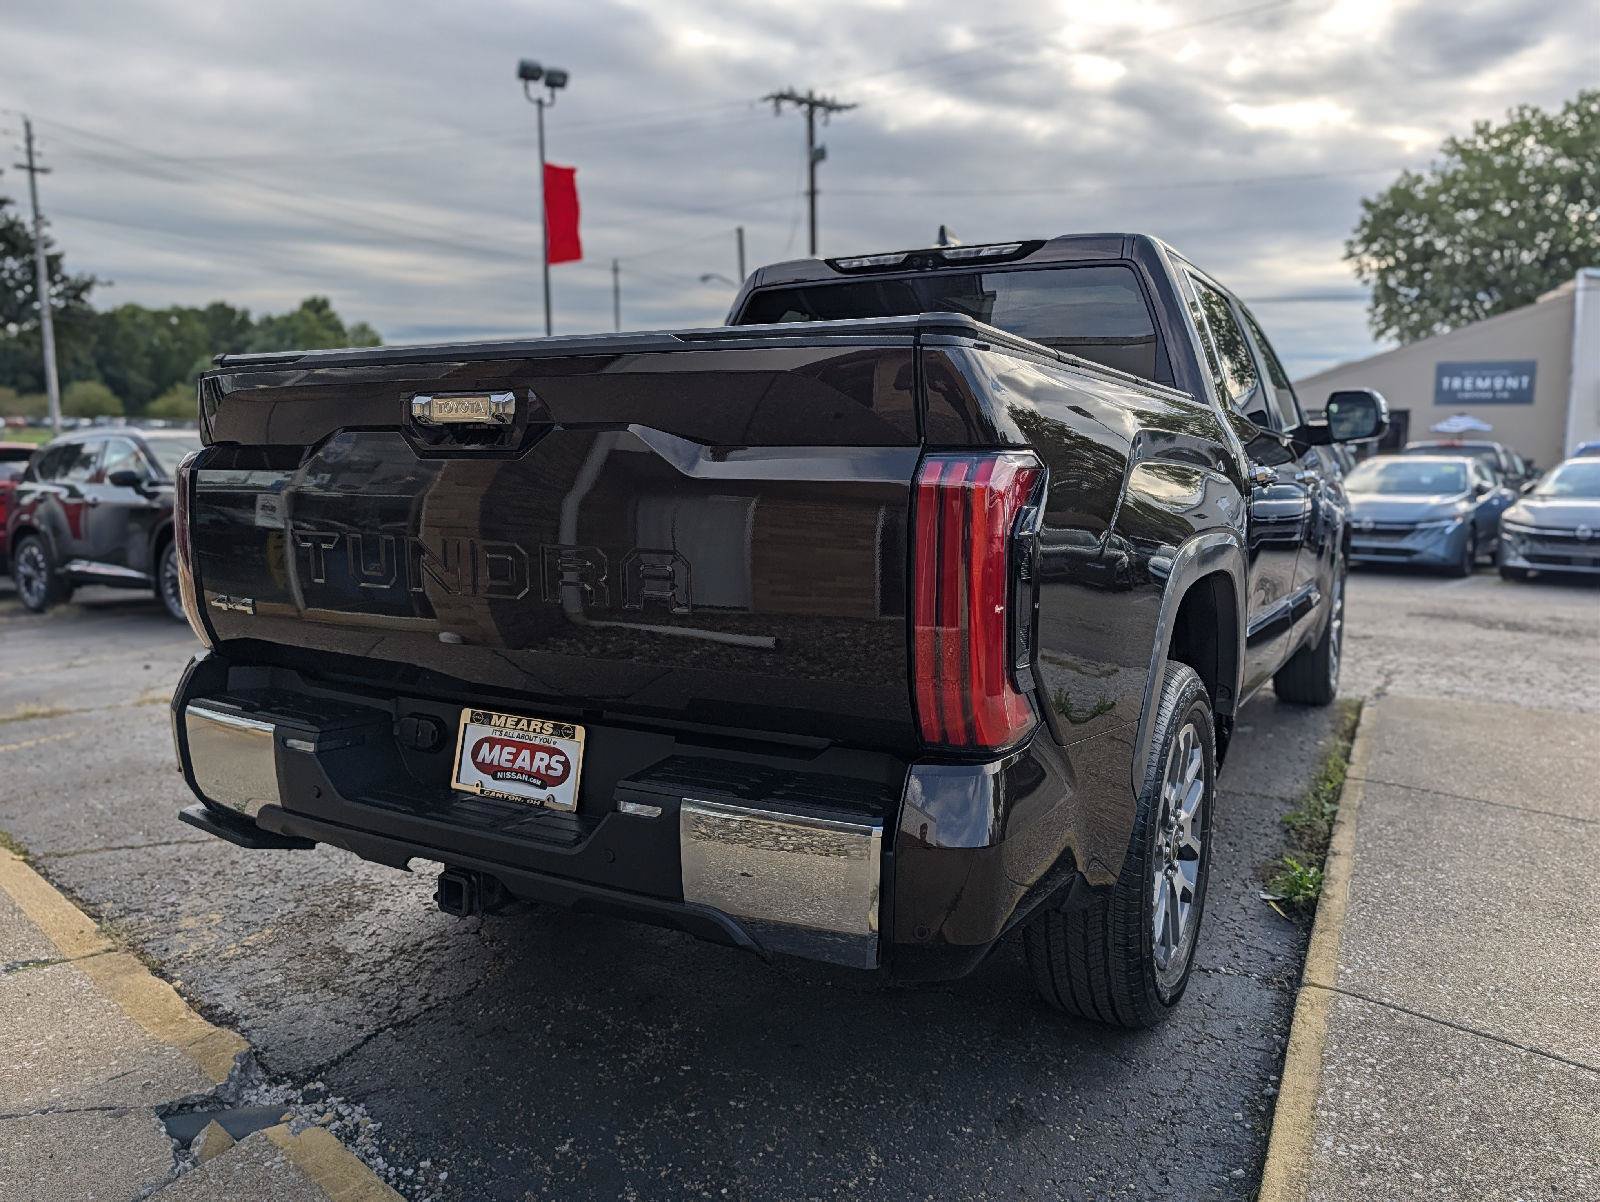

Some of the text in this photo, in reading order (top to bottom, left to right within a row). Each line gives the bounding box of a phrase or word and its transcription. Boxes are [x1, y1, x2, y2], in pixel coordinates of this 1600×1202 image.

[1441, 375, 1530, 391] TREMONT
[436, 400, 484, 414] TOYOTA
[292, 529, 692, 614] TUNDRA
[490, 714, 554, 735] MEARS
[491, 729, 552, 745] IT'S ALL ABOUT YOU
[476, 742, 566, 777] MEARS
